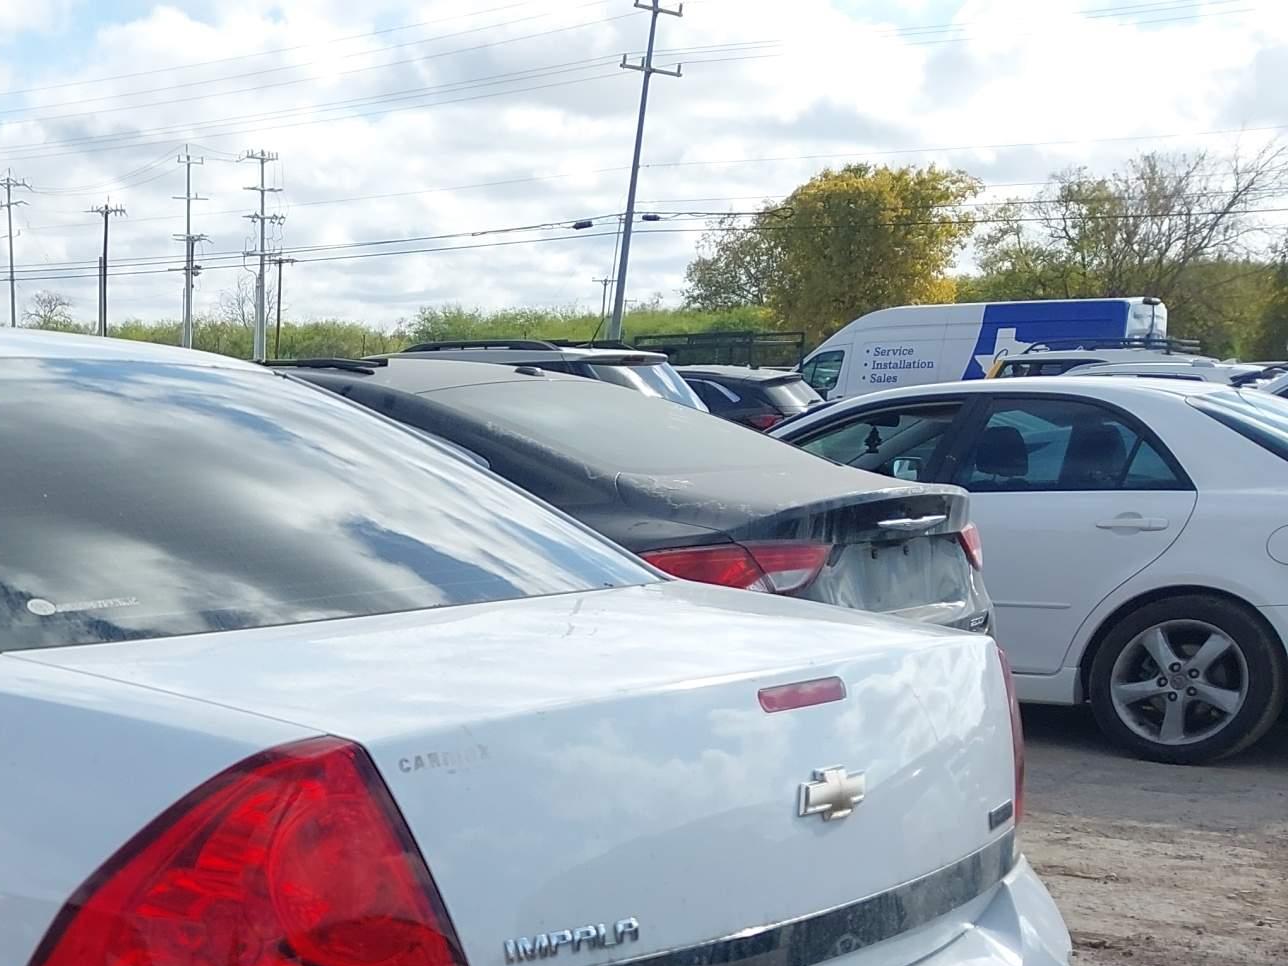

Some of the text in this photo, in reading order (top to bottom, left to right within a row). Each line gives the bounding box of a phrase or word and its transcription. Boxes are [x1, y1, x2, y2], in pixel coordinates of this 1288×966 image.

[873, 345, 914, 356] Service
[871, 359, 934, 369] Installation
[870, 373, 898, 383] Sales
[503, 916, 639, 965] IMPALA
